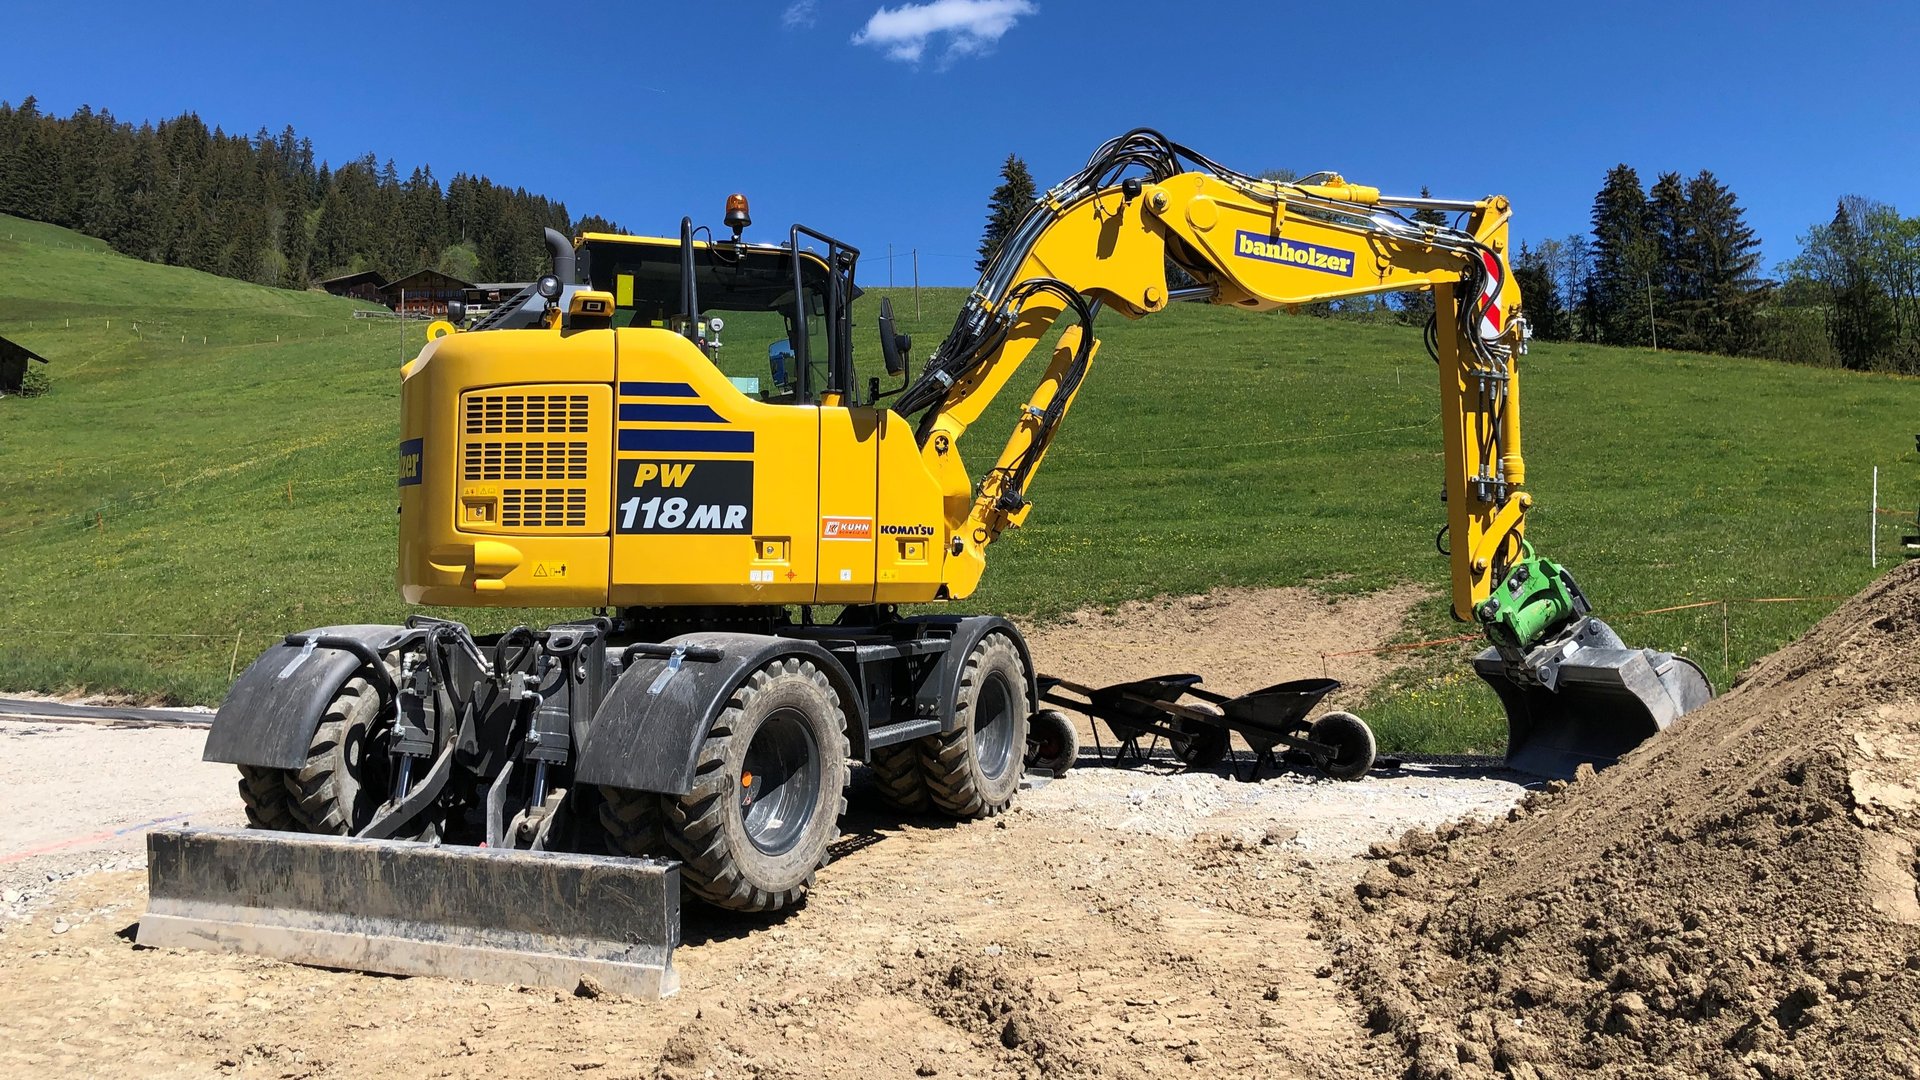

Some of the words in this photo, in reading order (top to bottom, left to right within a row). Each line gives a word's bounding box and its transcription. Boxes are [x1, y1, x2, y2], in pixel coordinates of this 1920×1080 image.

[1239, 234, 1351, 272] banholzer
[633, 463, 696, 488] PW
[841, 523, 869, 531] KUHN
[880, 524, 934, 536] KOMATSU
